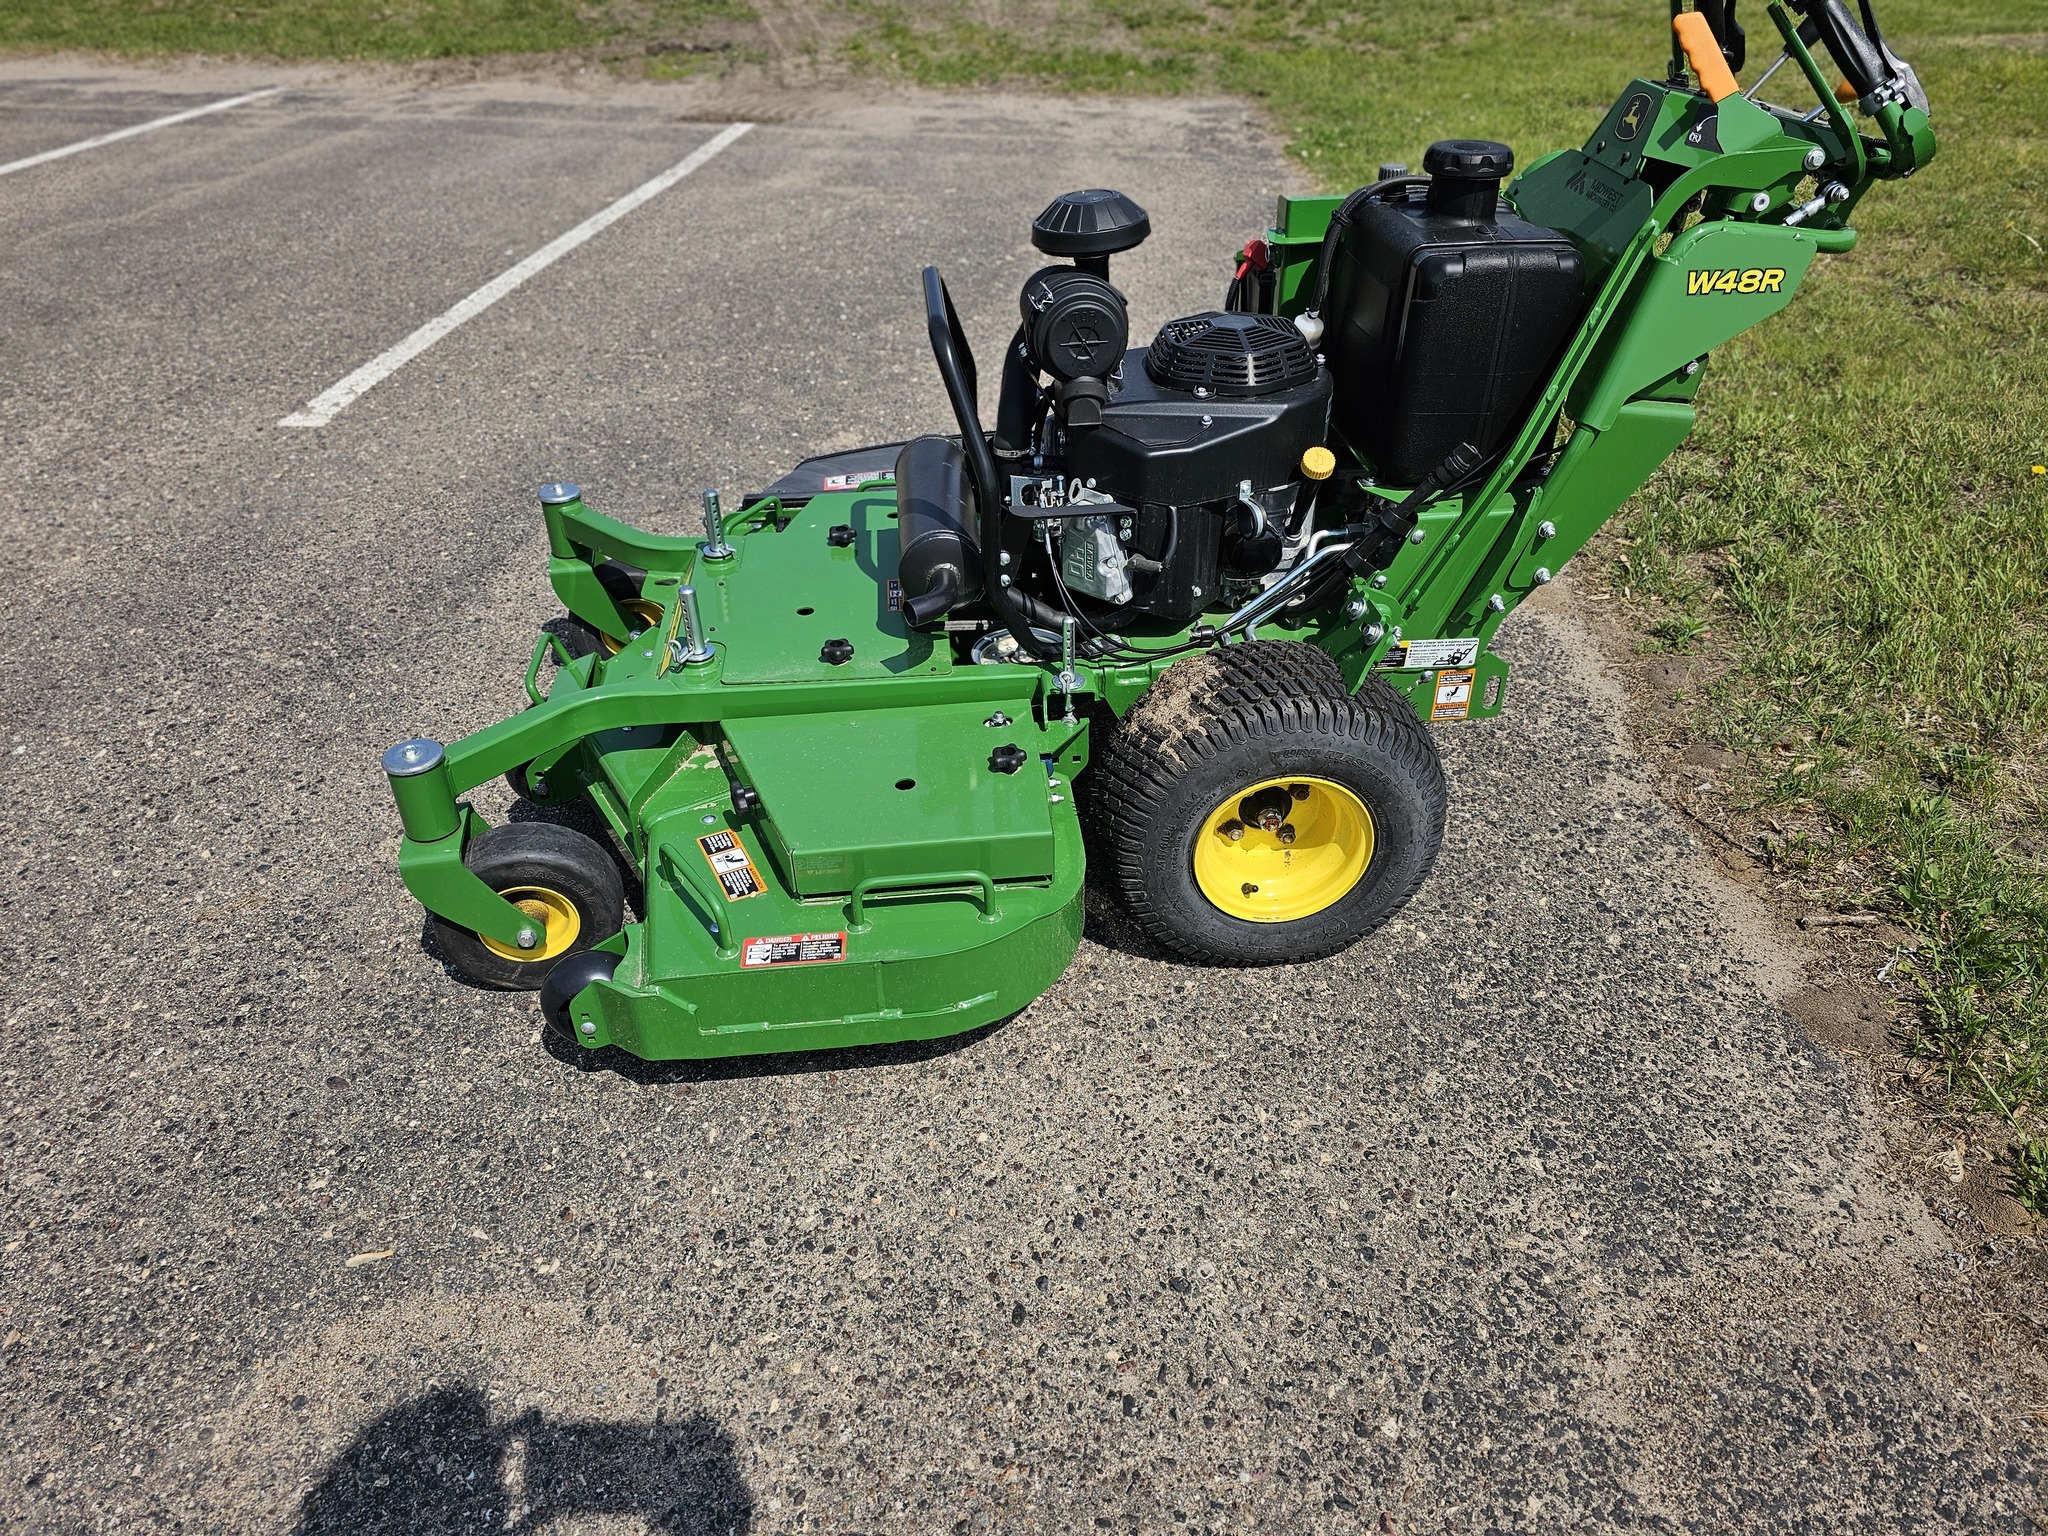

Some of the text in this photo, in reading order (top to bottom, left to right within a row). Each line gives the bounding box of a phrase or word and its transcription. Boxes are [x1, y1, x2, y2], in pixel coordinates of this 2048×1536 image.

[1590, 179, 1624, 203] MIDWEST
[1686, 268, 1786, 296] W48R
[1072, 309, 1096, 322] TOP
[1323, 750, 1393, 787] MASTER
[522, 867, 598, 905] CARLISLE
[765, 936, 792, 944] DANGER
[810, 932, 839, 941] PELIGRO
